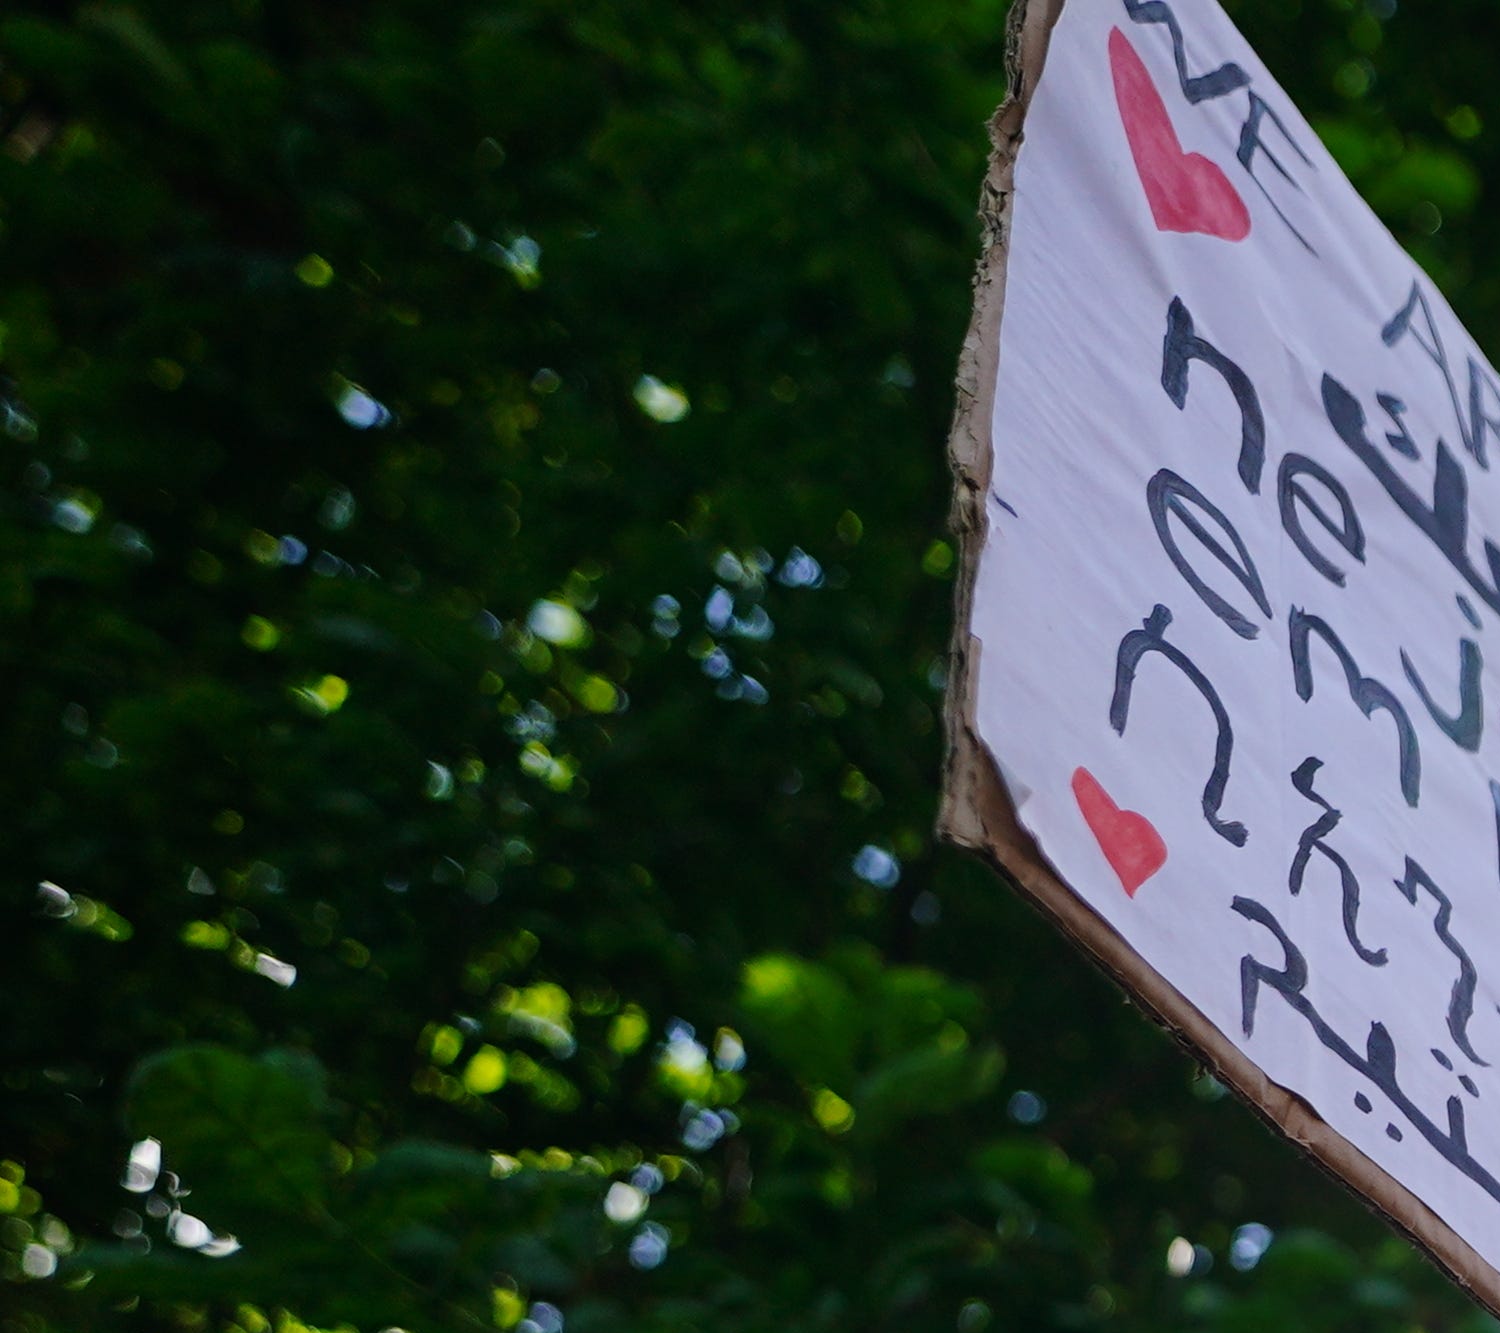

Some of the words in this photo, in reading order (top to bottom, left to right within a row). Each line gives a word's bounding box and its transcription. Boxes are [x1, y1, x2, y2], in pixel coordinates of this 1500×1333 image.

[1122, 0, 1320, 259] WE
[1160, 295, 1367, 587] ne
[1145, 467, 1421, 809] em
